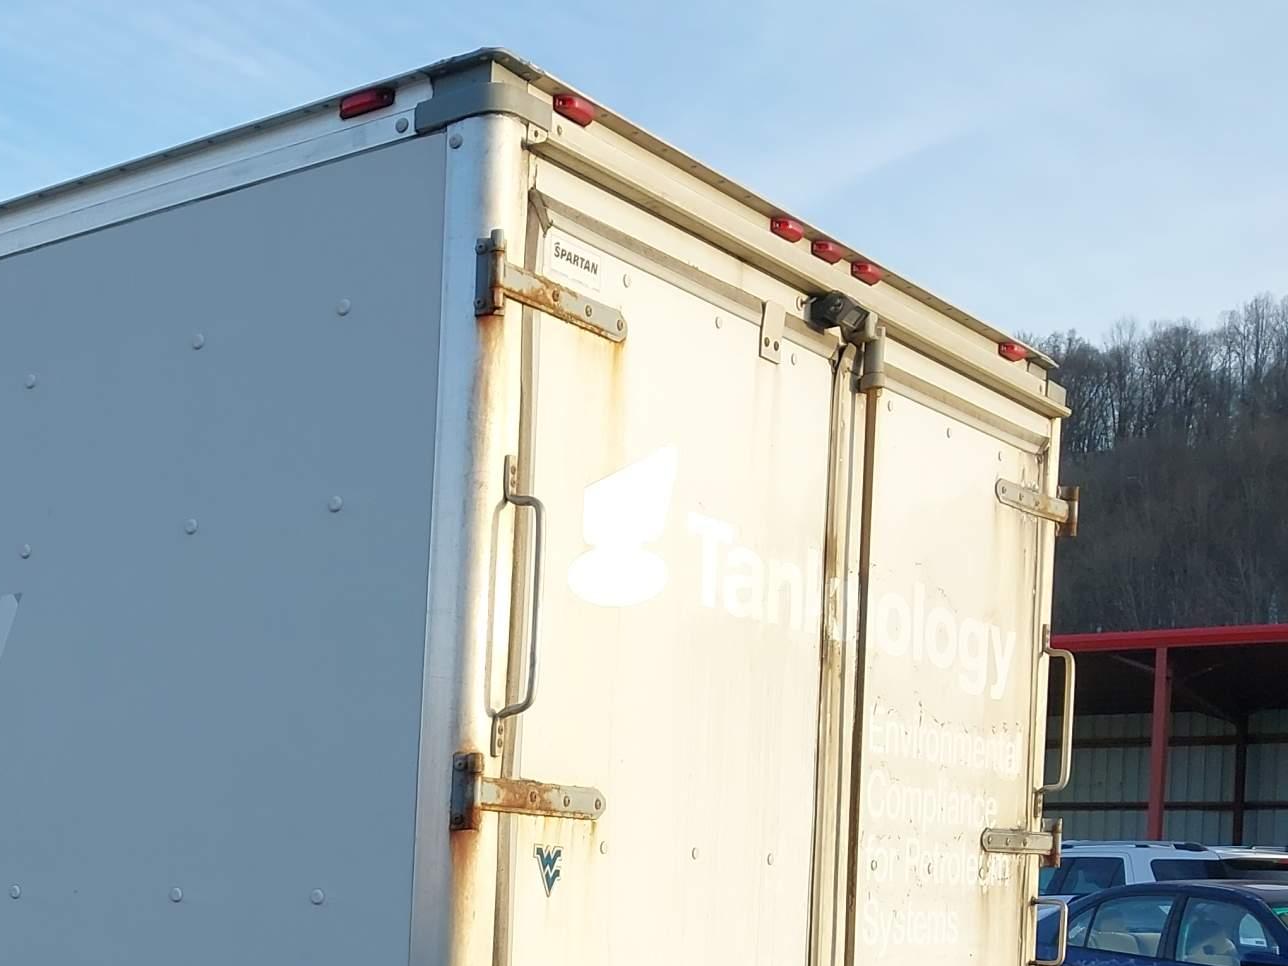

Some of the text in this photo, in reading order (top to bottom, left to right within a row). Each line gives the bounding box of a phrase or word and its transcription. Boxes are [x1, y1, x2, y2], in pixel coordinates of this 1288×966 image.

[553, 242, 599, 275] SPARTAN
[869, 706, 1022, 779] Environmental
[867, 769, 997, 831] Compliance
[862, 896, 958, 958] Systems
